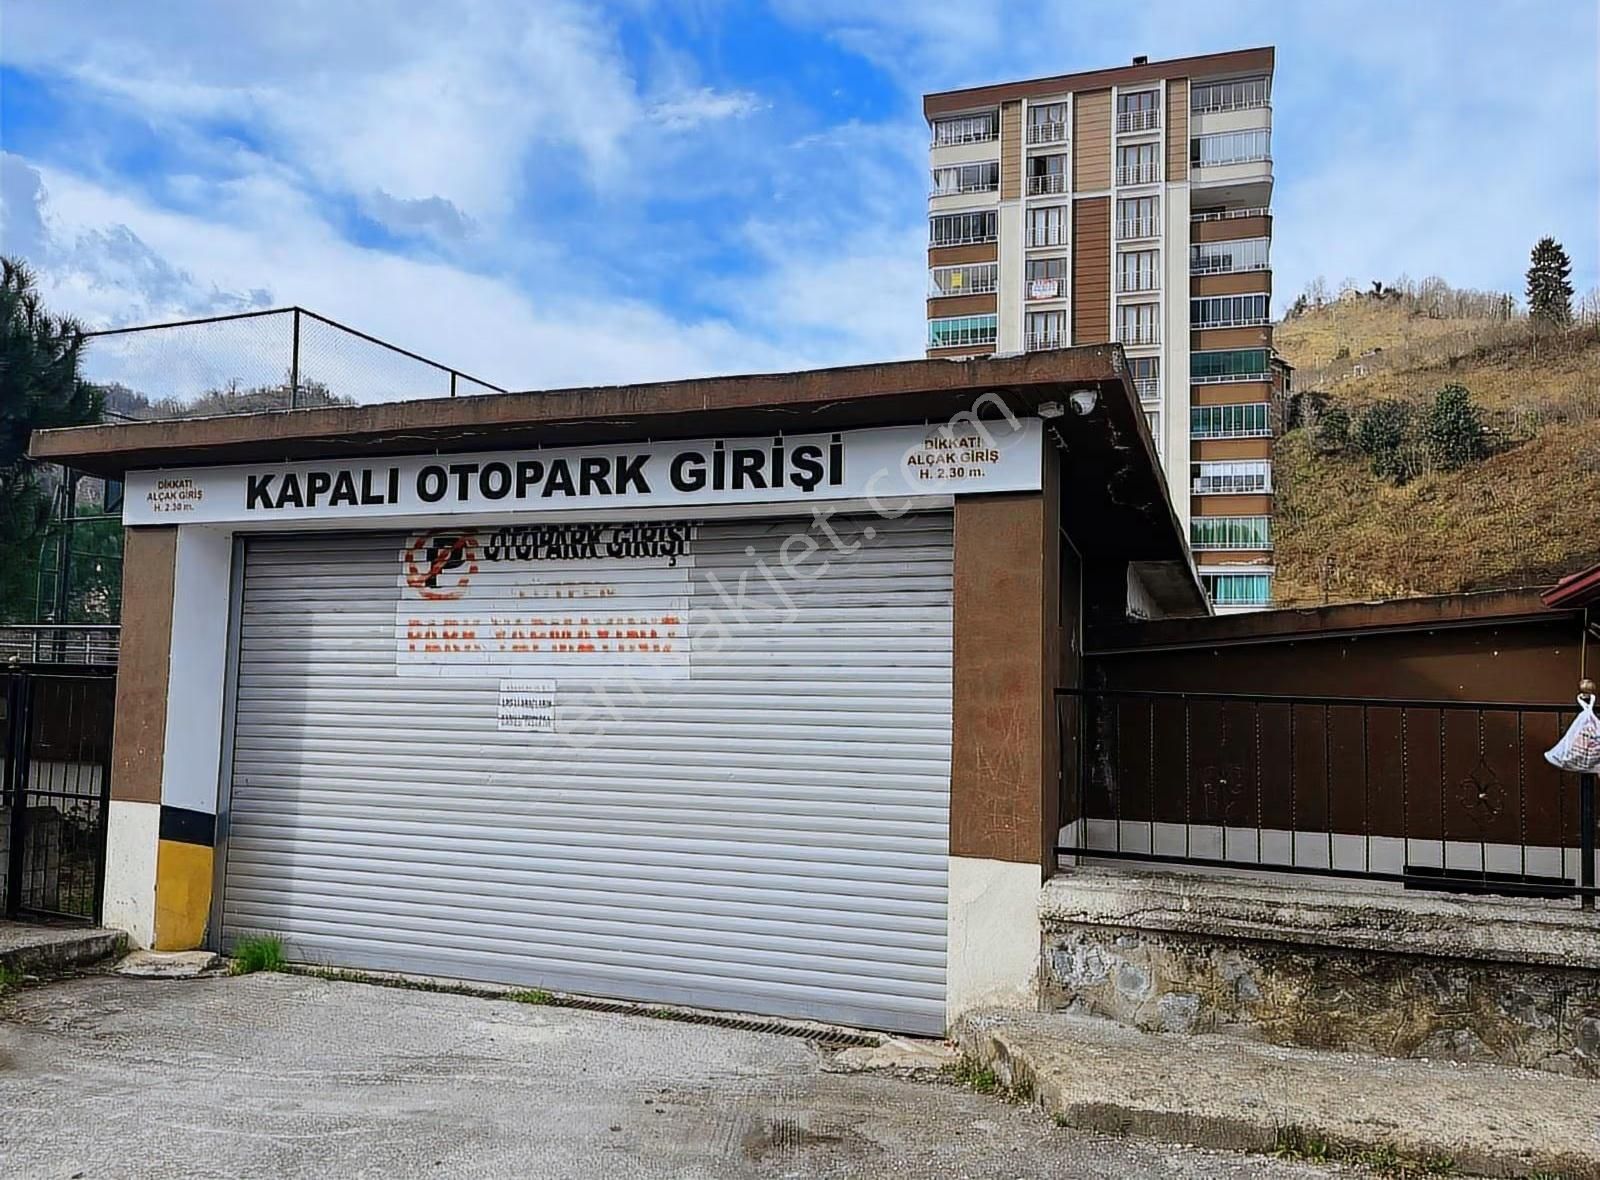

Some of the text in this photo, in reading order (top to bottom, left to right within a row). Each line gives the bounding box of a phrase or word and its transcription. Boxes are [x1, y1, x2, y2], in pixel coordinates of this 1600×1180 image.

[245, 431, 843, 510] KAPALI OTOPARK GİRİŞİ
[960, 448, 1000, 463] GİRİŞ
